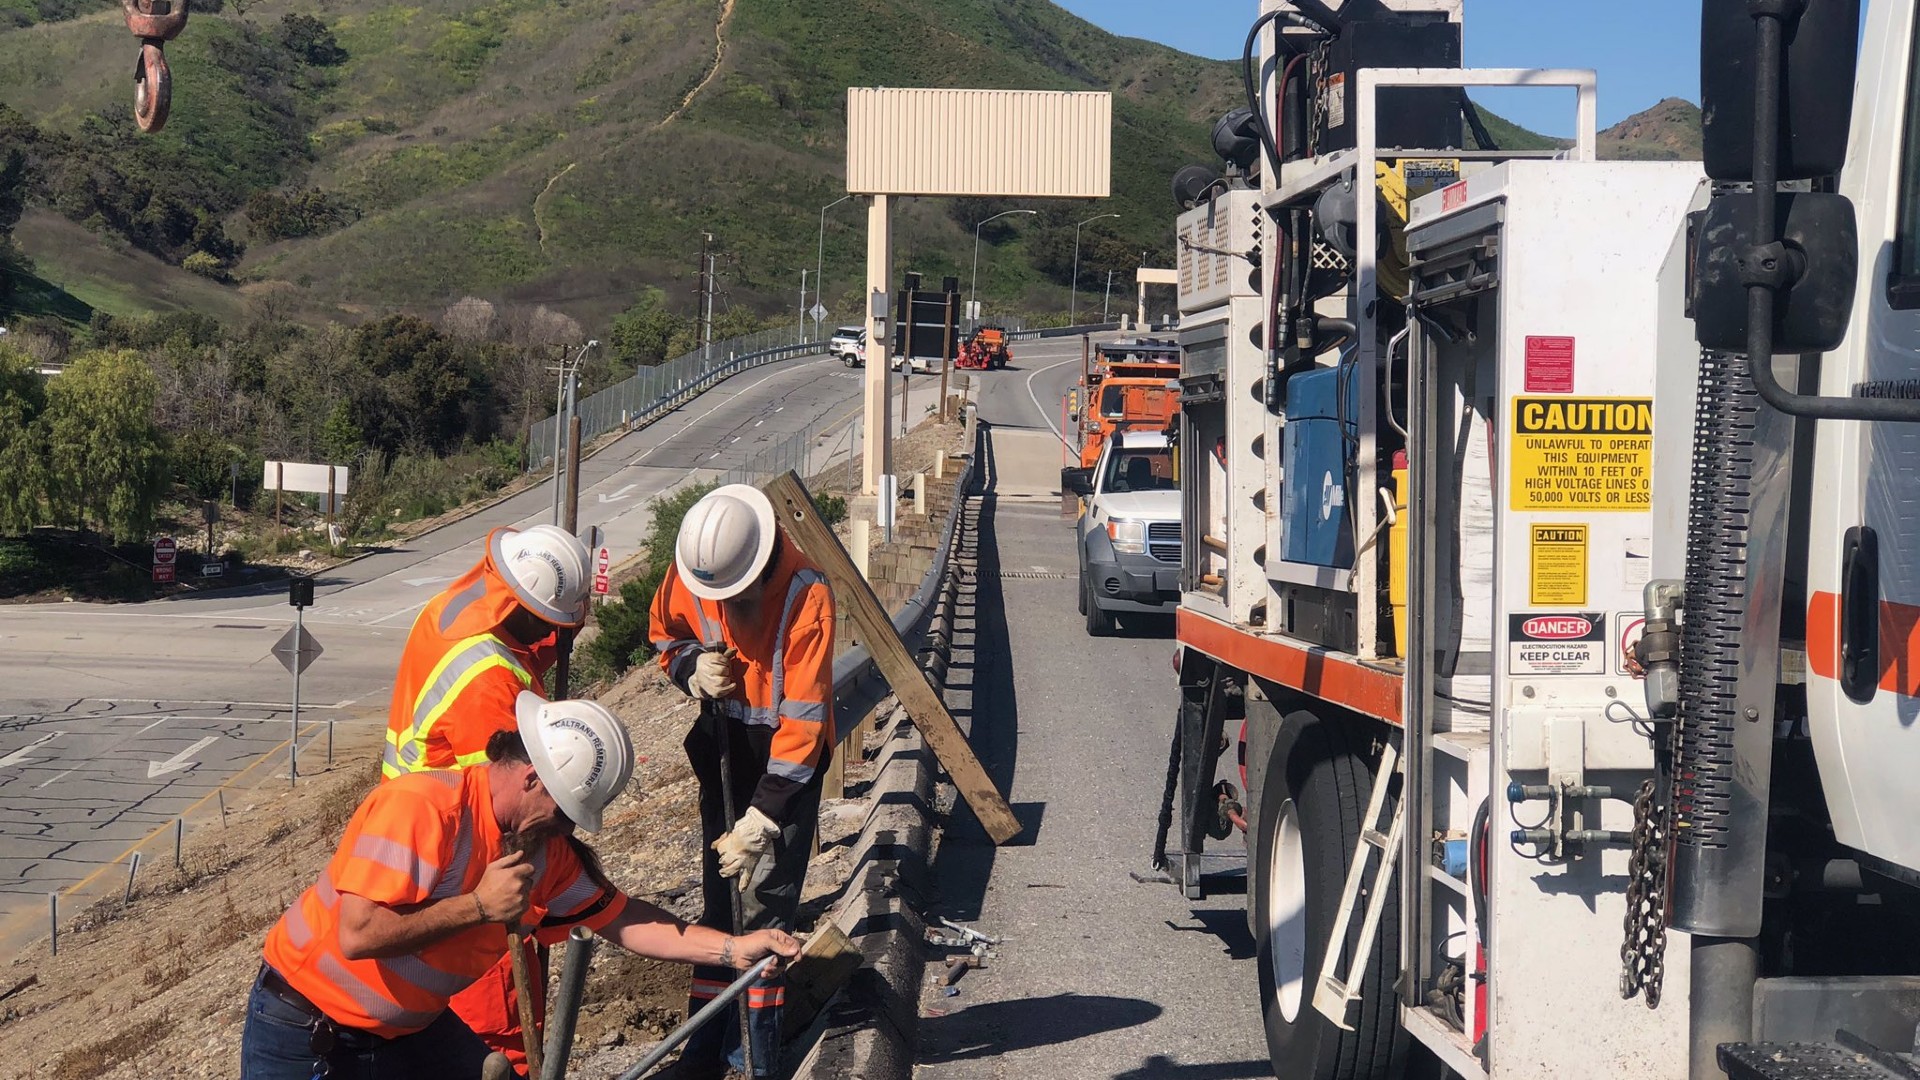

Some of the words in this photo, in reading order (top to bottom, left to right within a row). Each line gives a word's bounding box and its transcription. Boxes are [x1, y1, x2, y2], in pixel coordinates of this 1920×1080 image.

[1524, 403, 1652, 431] CAUTION
[1526, 439, 1586, 450] UNLAWFUL
[1590, 440, 1603, 450] TO
[1609, 440, 1652, 450] OPERAT
[1544, 453, 1568, 463] THIS
[1576, 453, 1639, 464] EQUIPMENT
[1538, 466, 1578, 477] WITHIN
[1584, 467, 1595, 477] 10
[1601, 467, 1626, 477] FEET
[1630, 467, 1644, 477] OF
[1525, 478, 1551, 489] HIGH
[1556, 478, 1602, 490] VOLTAGE
[1606, 479, 1637, 490] LINES
[1530, 491, 1563, 504] 50,000
[1569, 491, 1601, 503] VOLTS
[1606, 492, 1620, 503] OR
[1625, 492, 1650, 503] LESS
[1536, 530, 1583, 541] CAUTION
[1527, 621, 1587, 634] DANGER
[1520, 651, 1550, 661] KEEP
[1552, 651, 1590, 661] CLEAR
[555, 720, 595, 738] CALTRANS
[584, 737, 604, 788] REMEMBERS
